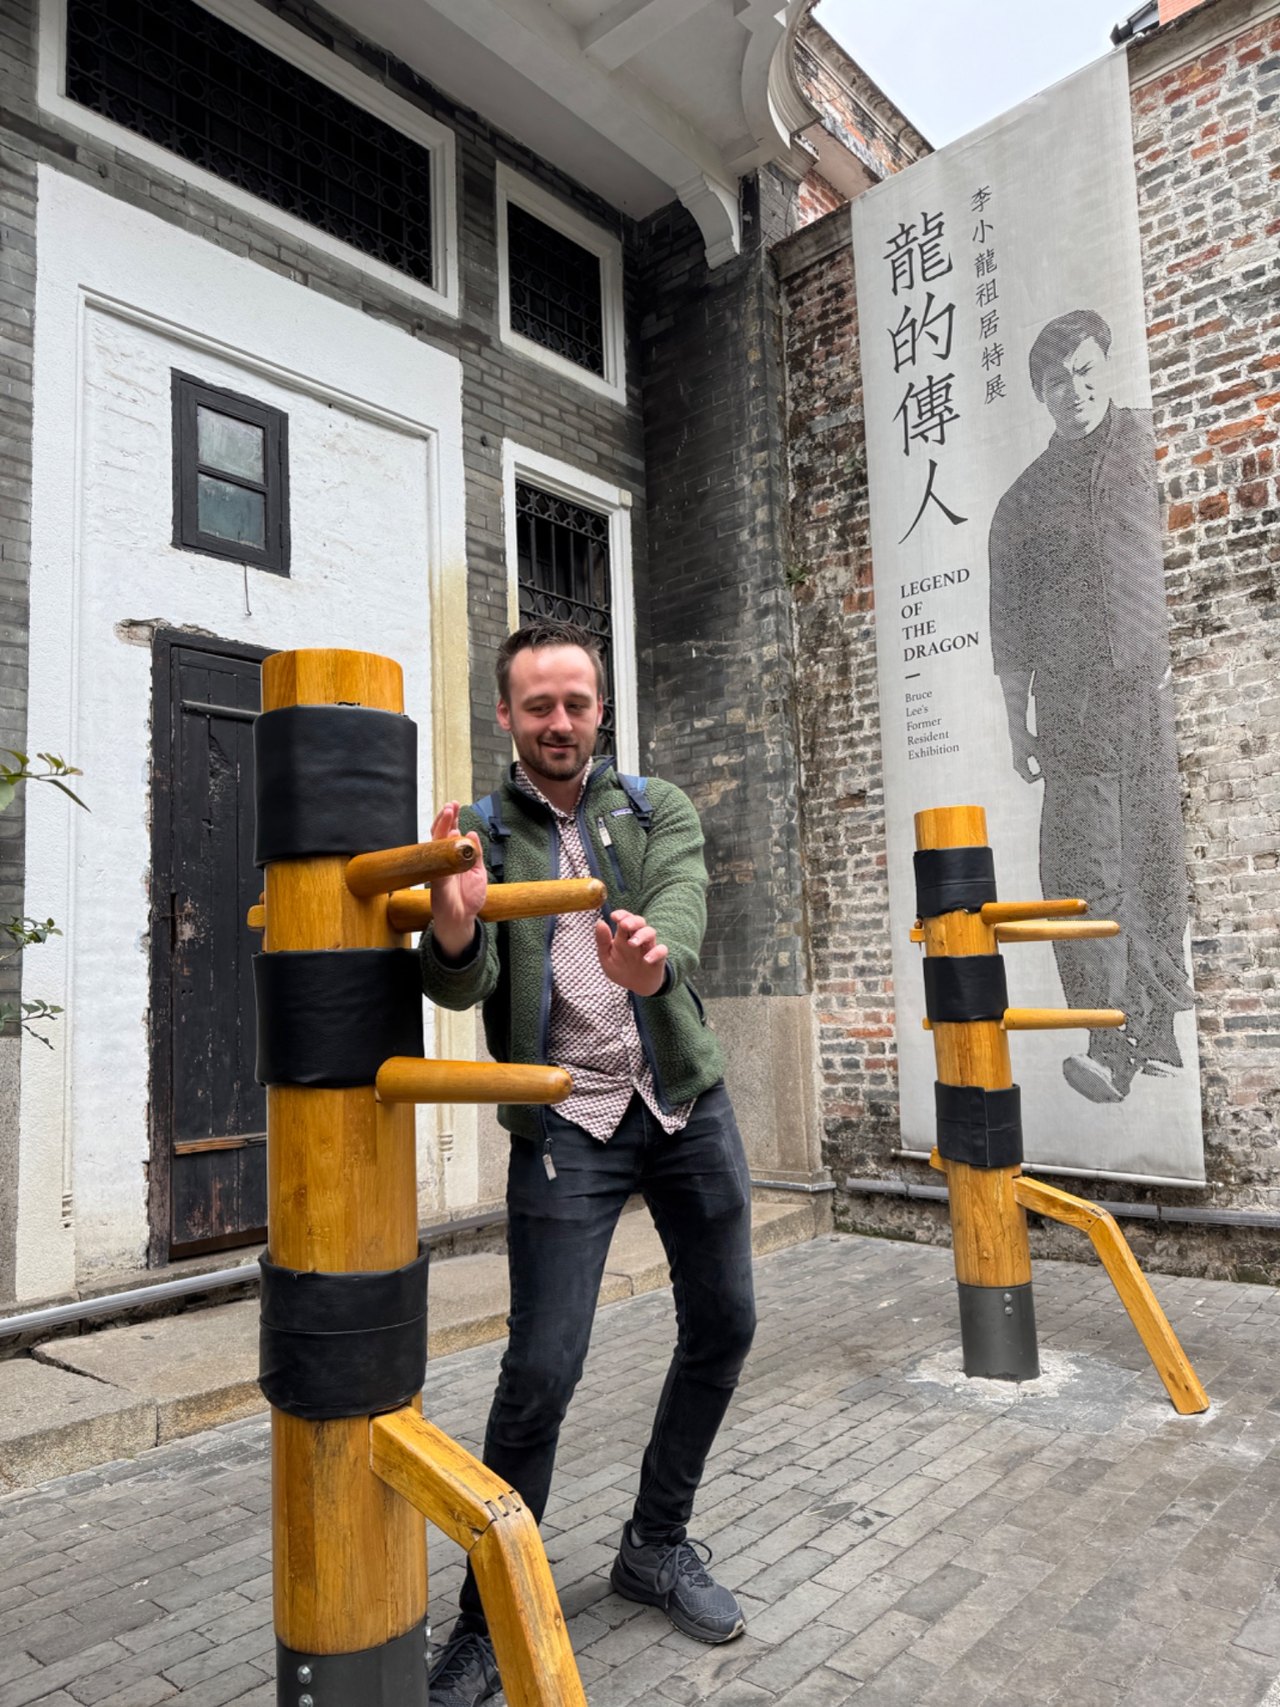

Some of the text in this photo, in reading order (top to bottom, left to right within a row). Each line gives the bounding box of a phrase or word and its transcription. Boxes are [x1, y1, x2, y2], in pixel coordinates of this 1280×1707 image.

[970, 185, 1007, 405] 李小龍祖居特展
[883, 211, 968, 545] 龍的傳人
[900, 568, 970, 599] LEGEND
[901, 601, 923, 619] OF
[902, 620, 937, 641] THE
[903, 631, 980, 662] DRAGON
[905, 689, 933, 703] Bruce
[905, 704, 929, 718] Lee's
[906, 717, 942, 732] Former
[907, 730, 949, 746] Resident
[908, 743, 960, 761] Exhibition
